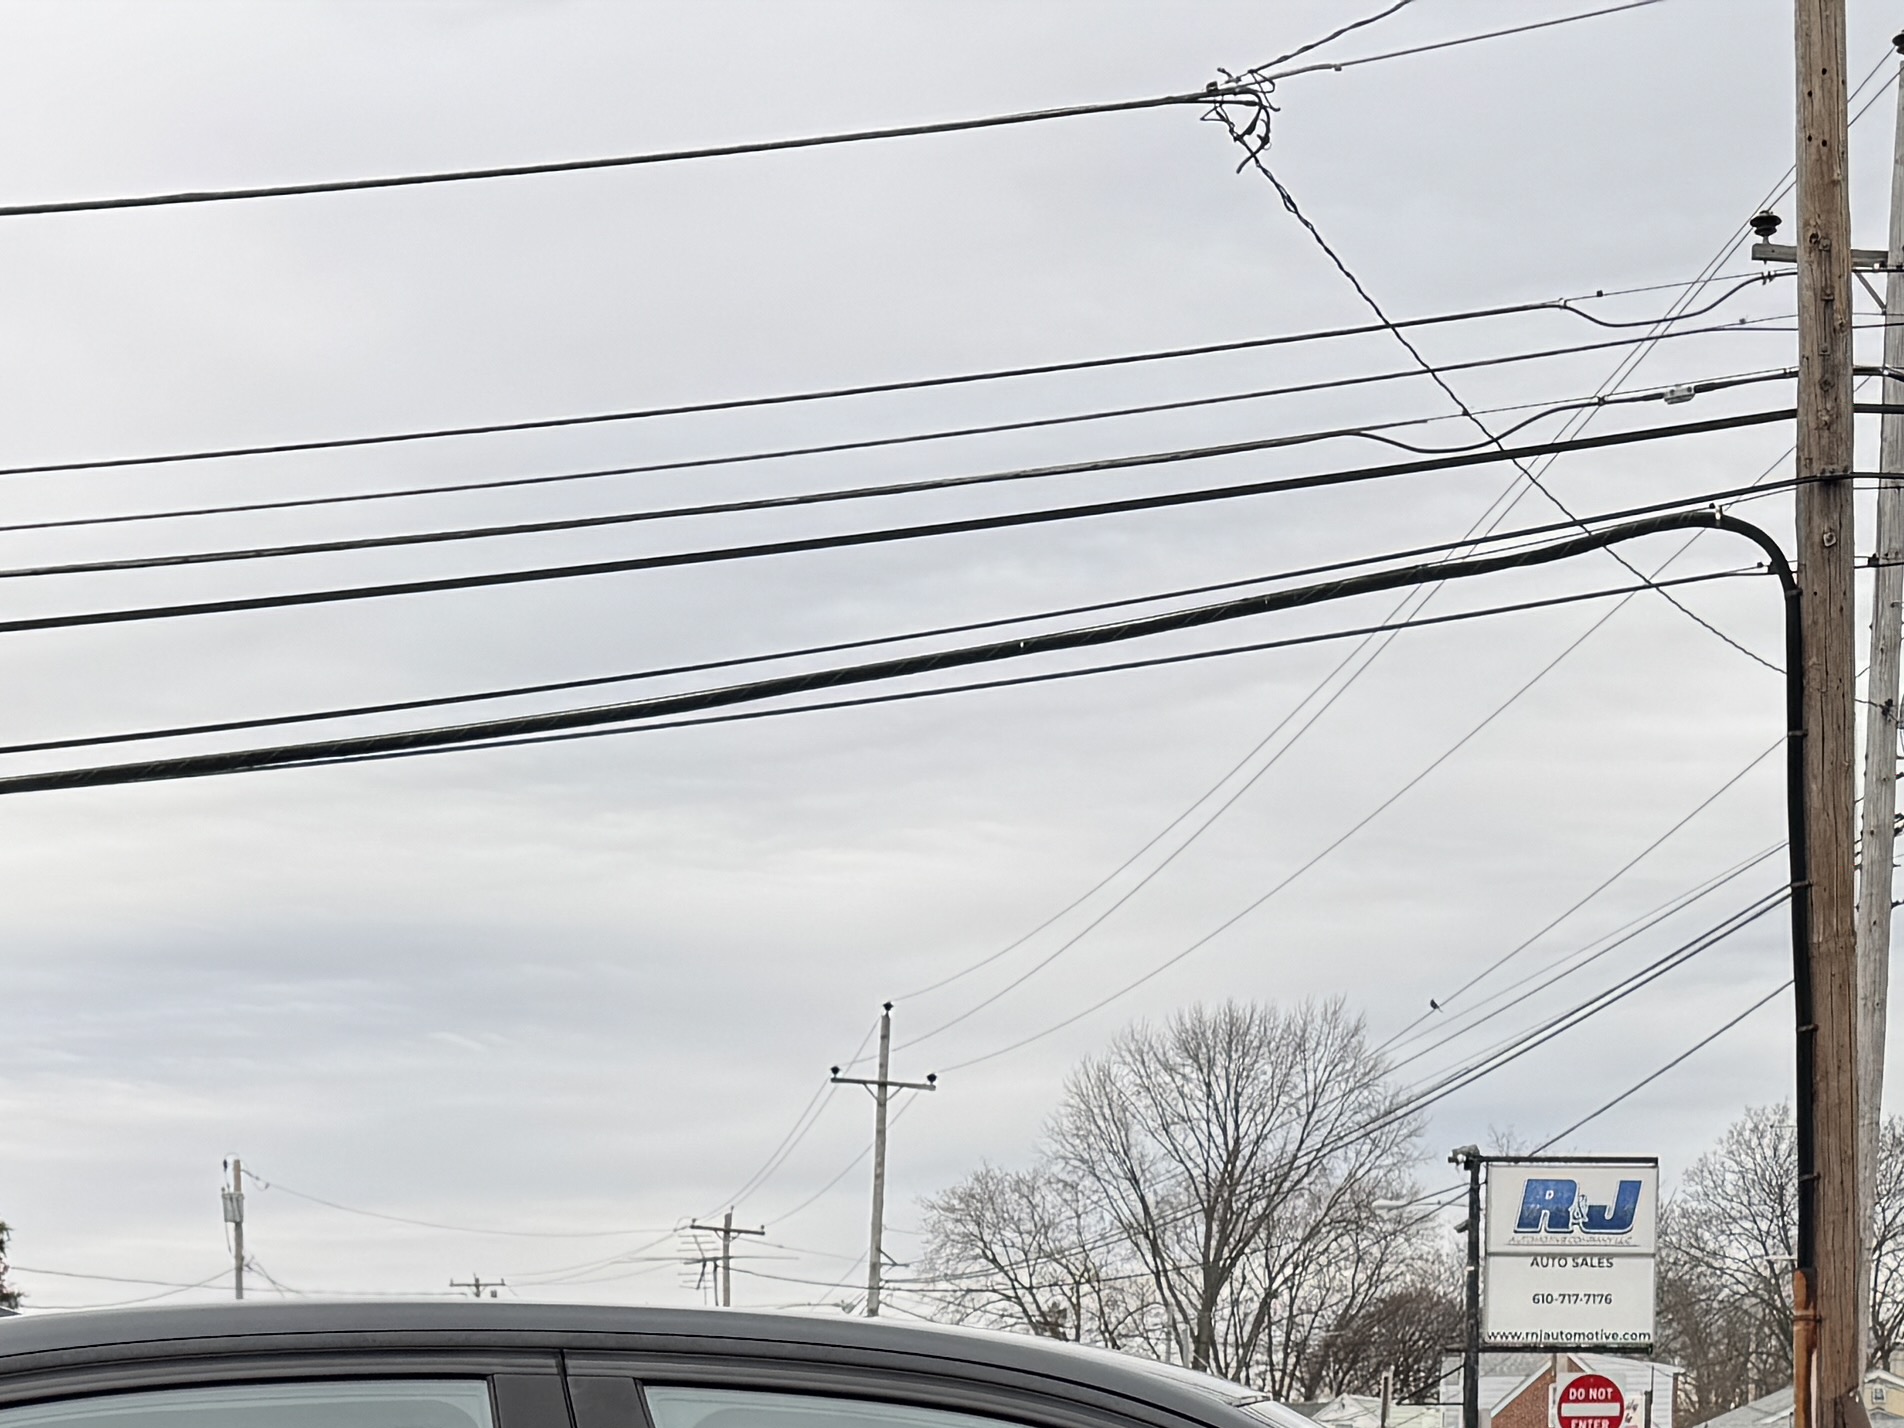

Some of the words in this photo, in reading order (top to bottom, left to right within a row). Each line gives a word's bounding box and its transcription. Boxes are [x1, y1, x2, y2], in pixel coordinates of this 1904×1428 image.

[1530, 1257, 1568, 1268] AUTO
[1572, 1258, 1615, 1269] SALES
[1532, 1293, 1613, 1305] 610-717-7176
[1487, 1329, 1651, 1343] www.rnjautomotive.com
[1568, 1388, 1586, 1400] DO
[1589, 1387, 1614, 1400] NOT
